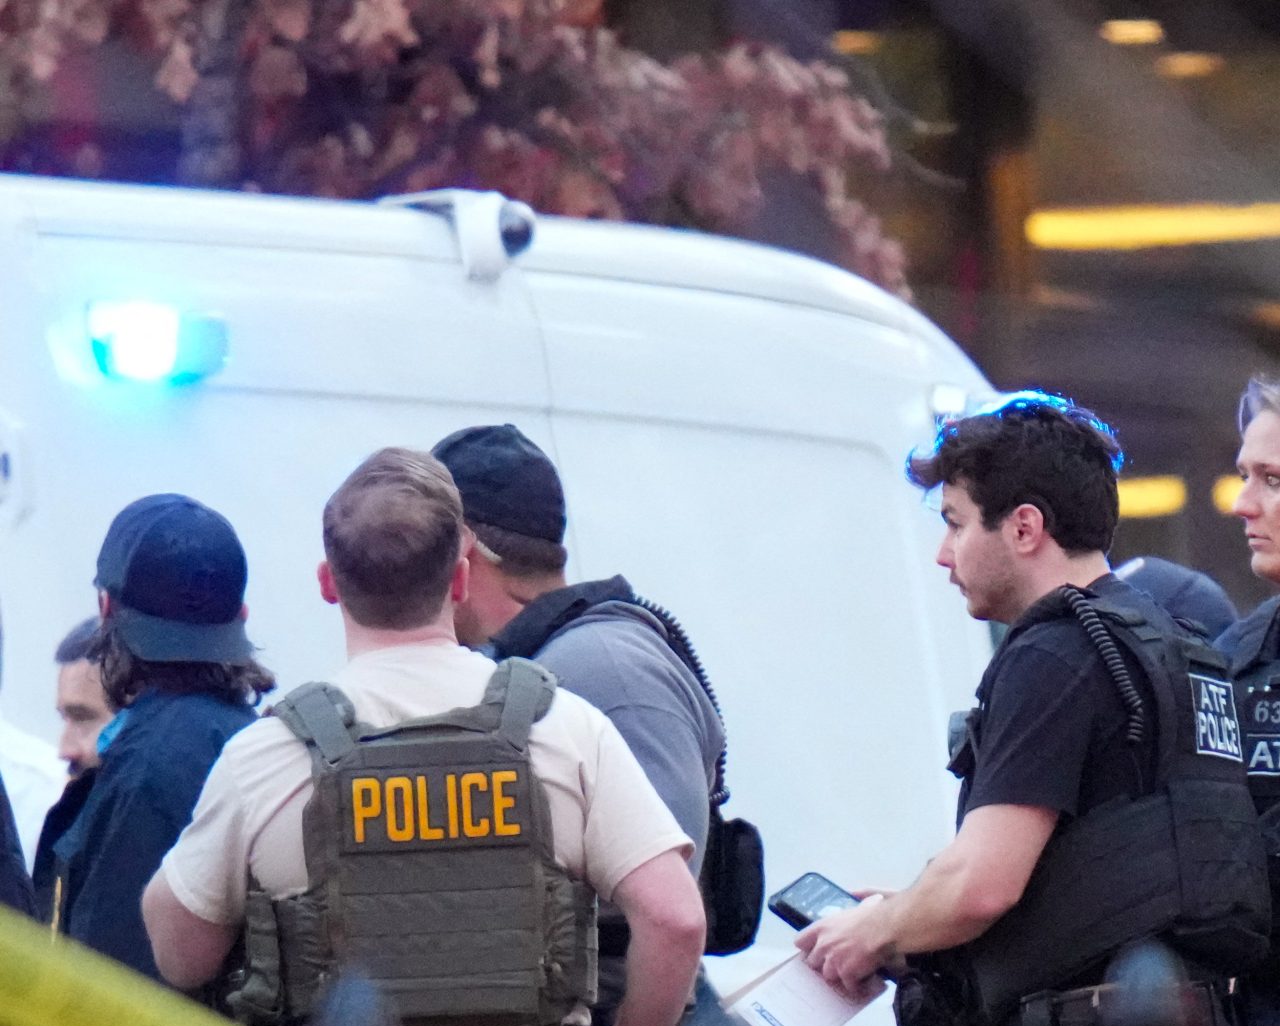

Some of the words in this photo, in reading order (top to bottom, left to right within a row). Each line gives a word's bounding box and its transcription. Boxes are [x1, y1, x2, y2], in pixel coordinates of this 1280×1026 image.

[1200, 681, 1228, 715] ATF
[1197, 710, 1239, 755] POLICE
[352, 770, 521, 843] POLICE
